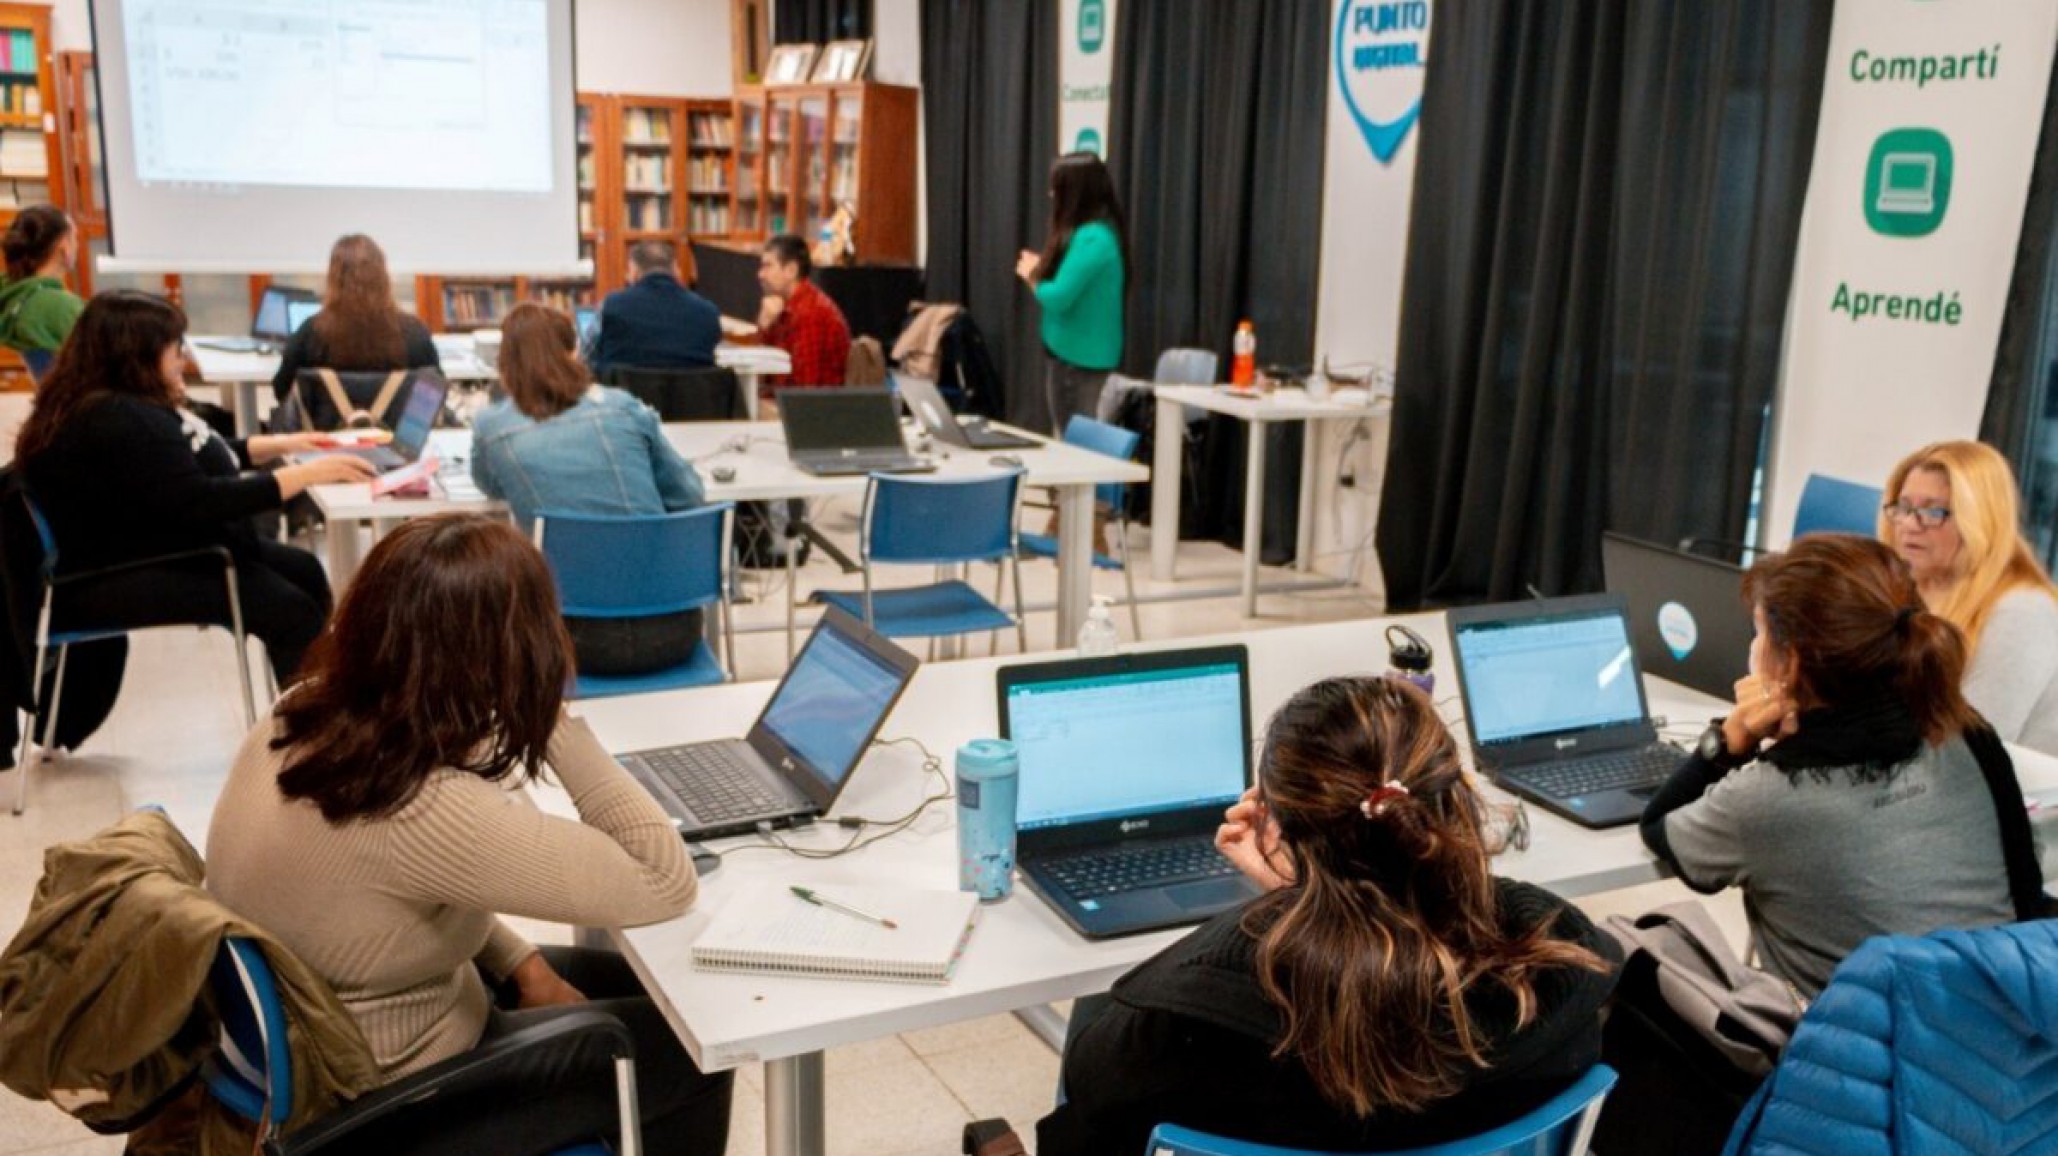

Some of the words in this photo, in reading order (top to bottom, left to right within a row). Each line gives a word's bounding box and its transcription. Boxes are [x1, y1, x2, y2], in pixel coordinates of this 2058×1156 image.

[1354, 2, 1427, 33] PUNTO
[1851, 43, 2000, 88] Compartí
[1831, 282, 1962, 325] Aprendé
